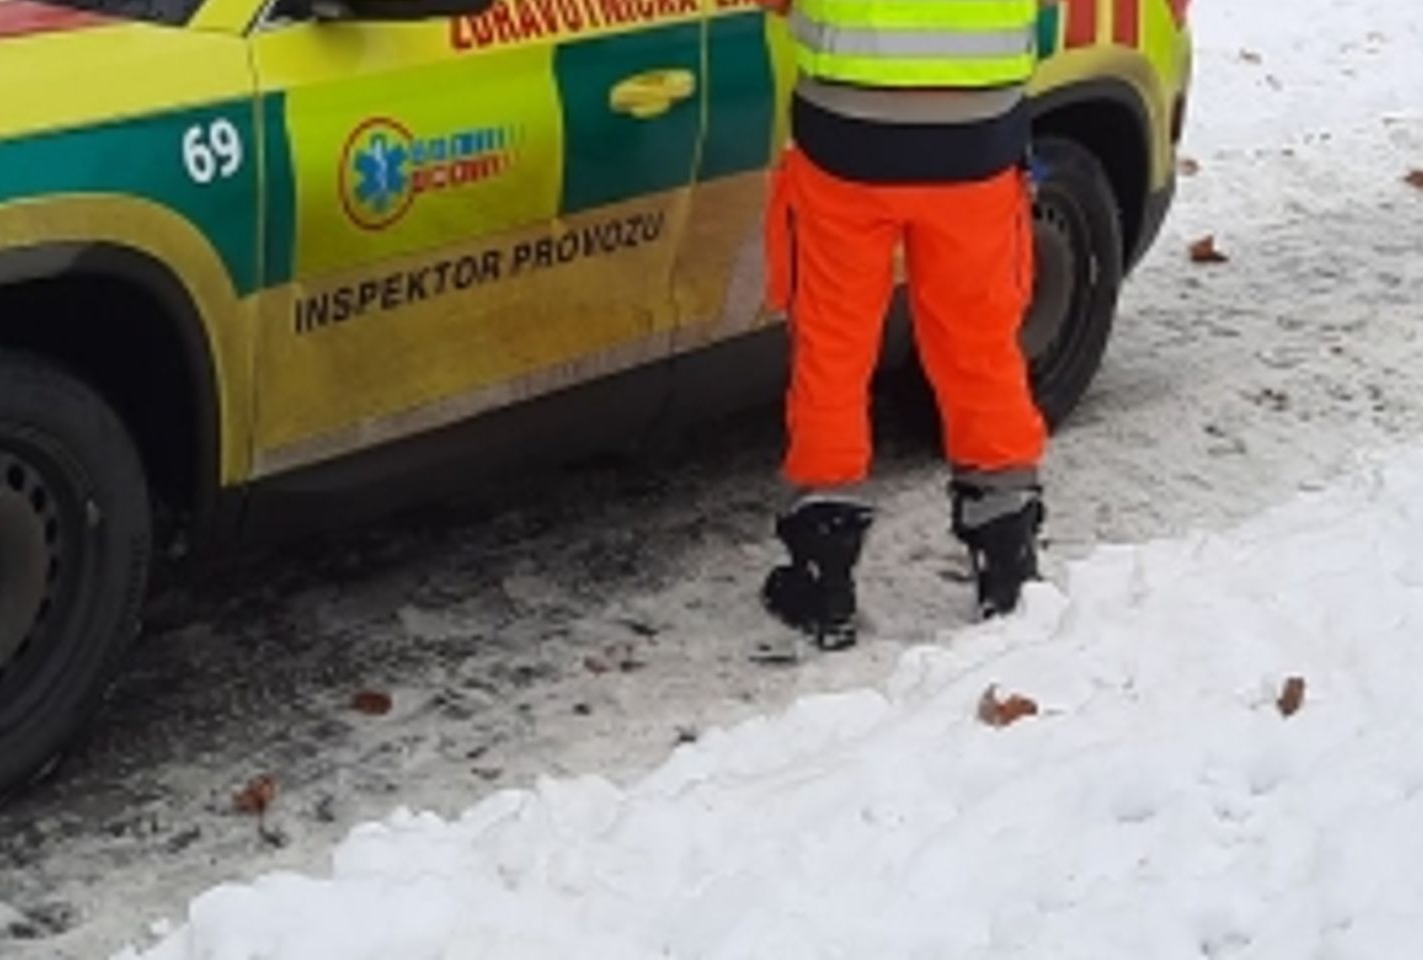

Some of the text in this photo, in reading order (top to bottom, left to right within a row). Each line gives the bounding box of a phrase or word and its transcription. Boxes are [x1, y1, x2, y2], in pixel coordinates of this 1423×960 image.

[182, 118, 243, 183] 69
[294, 212, 666, 335] INSPEKTOR PROVOZU
